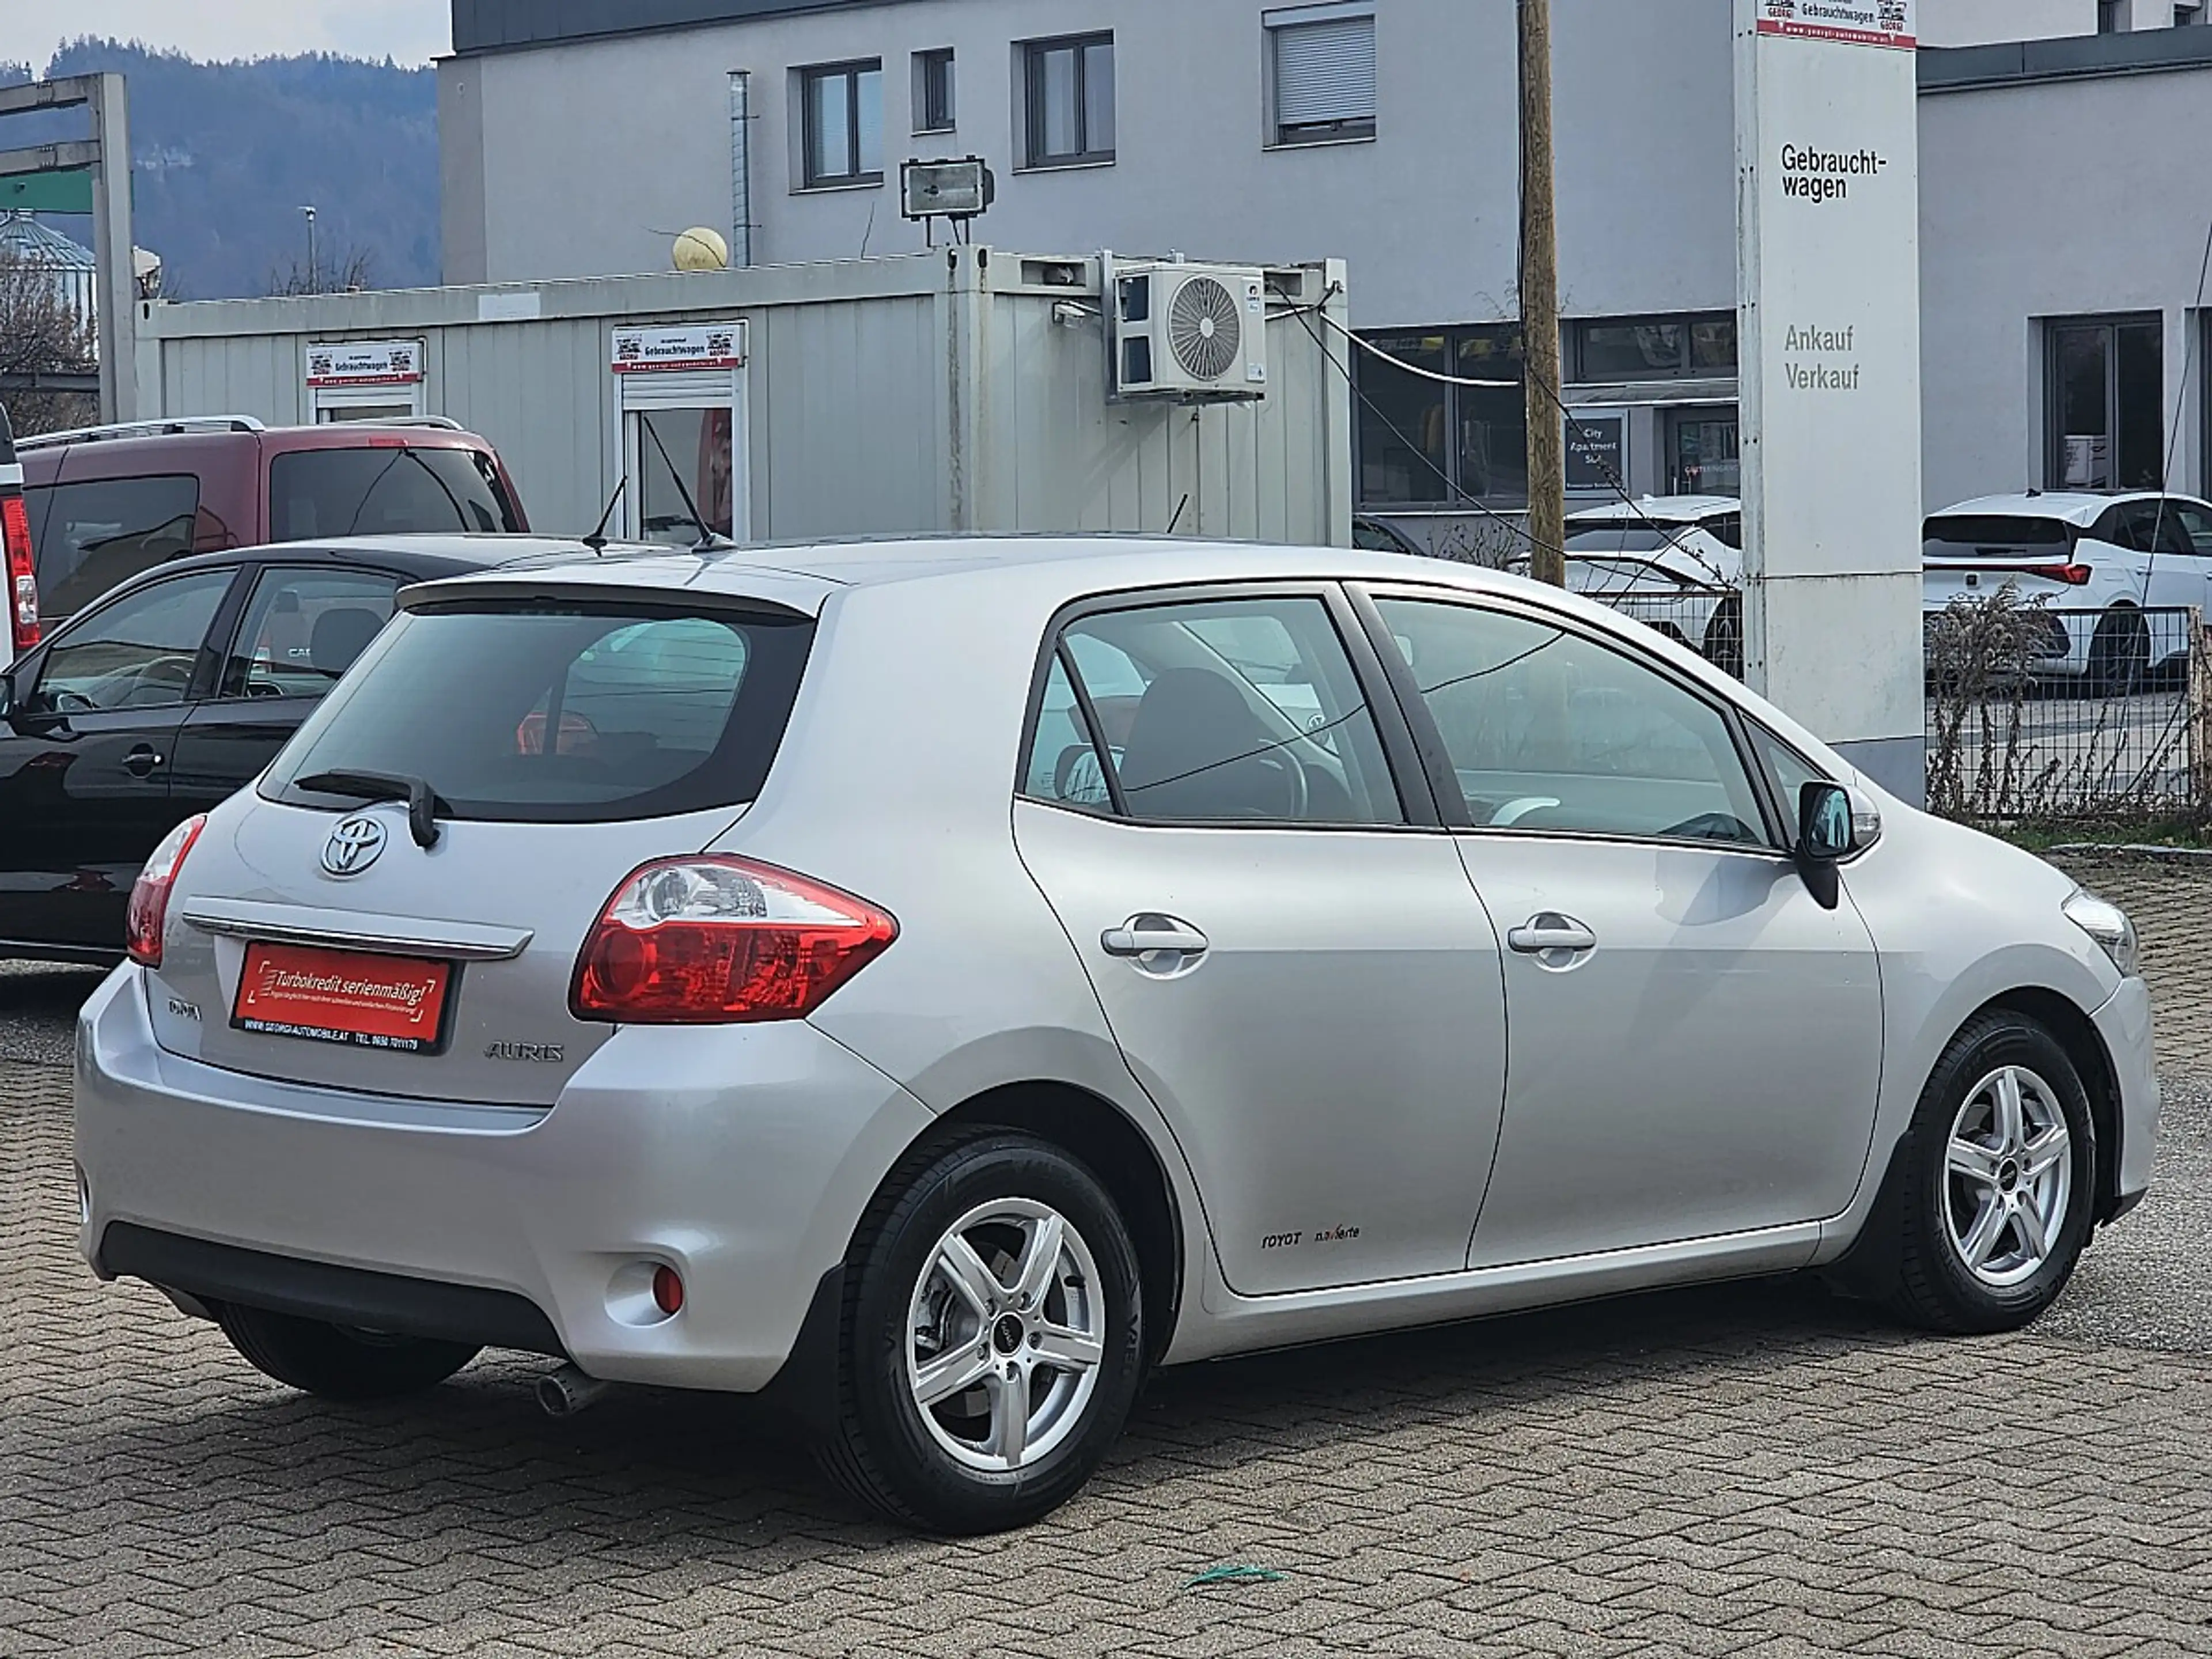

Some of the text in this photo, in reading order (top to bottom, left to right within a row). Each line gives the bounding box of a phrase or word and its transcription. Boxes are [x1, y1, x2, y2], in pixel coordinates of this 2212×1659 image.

[1802, 3, 1875, 24] Gebrauchtwagen
[1782, 144, 1887, 174] Gebraucht-
[1782, 176, 1846, 203] wagen
[1785, 324, 1854, 351] Ankauf
[1785, 363, 1859, 389] Verkauf
[1584, 427, 1603, 439] City
[275, 970, 342, 994] Turbokredit
[342, 978, 427, 1006] serienmäßig!
[483, 1039, 565, 1062] AURIS
